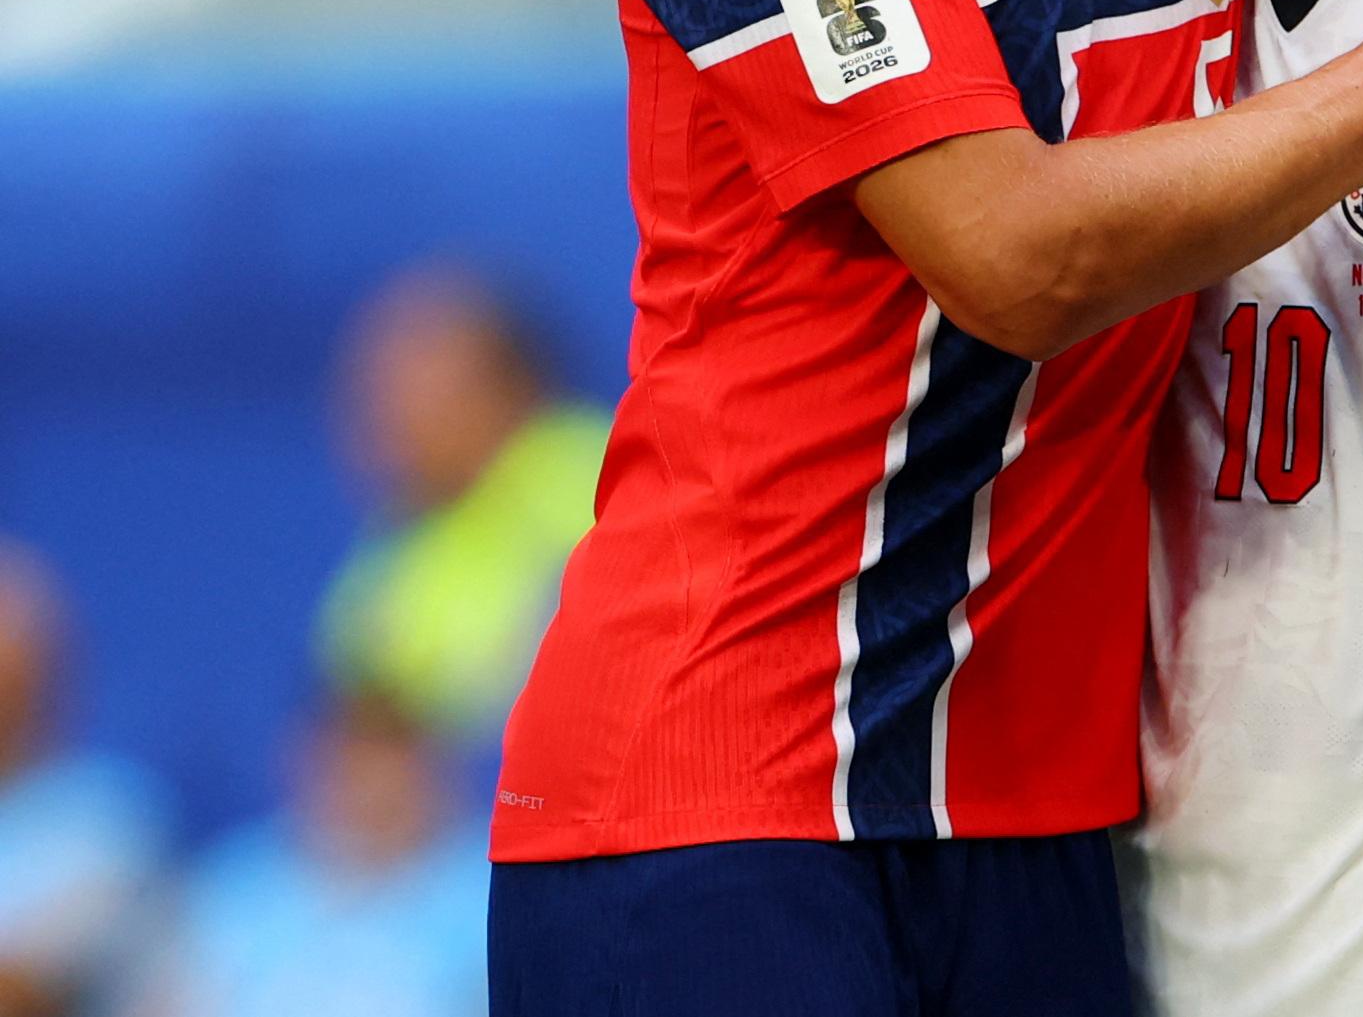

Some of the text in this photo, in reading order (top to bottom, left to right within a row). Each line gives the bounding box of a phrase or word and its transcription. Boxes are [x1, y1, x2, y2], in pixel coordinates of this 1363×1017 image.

[846, 29, 875, 47] FIFA
[838, 45, 894, 71] WORLD CUP
[842, 55, 899, 84] 2026
[1215, 302, 1332, 505] 10
